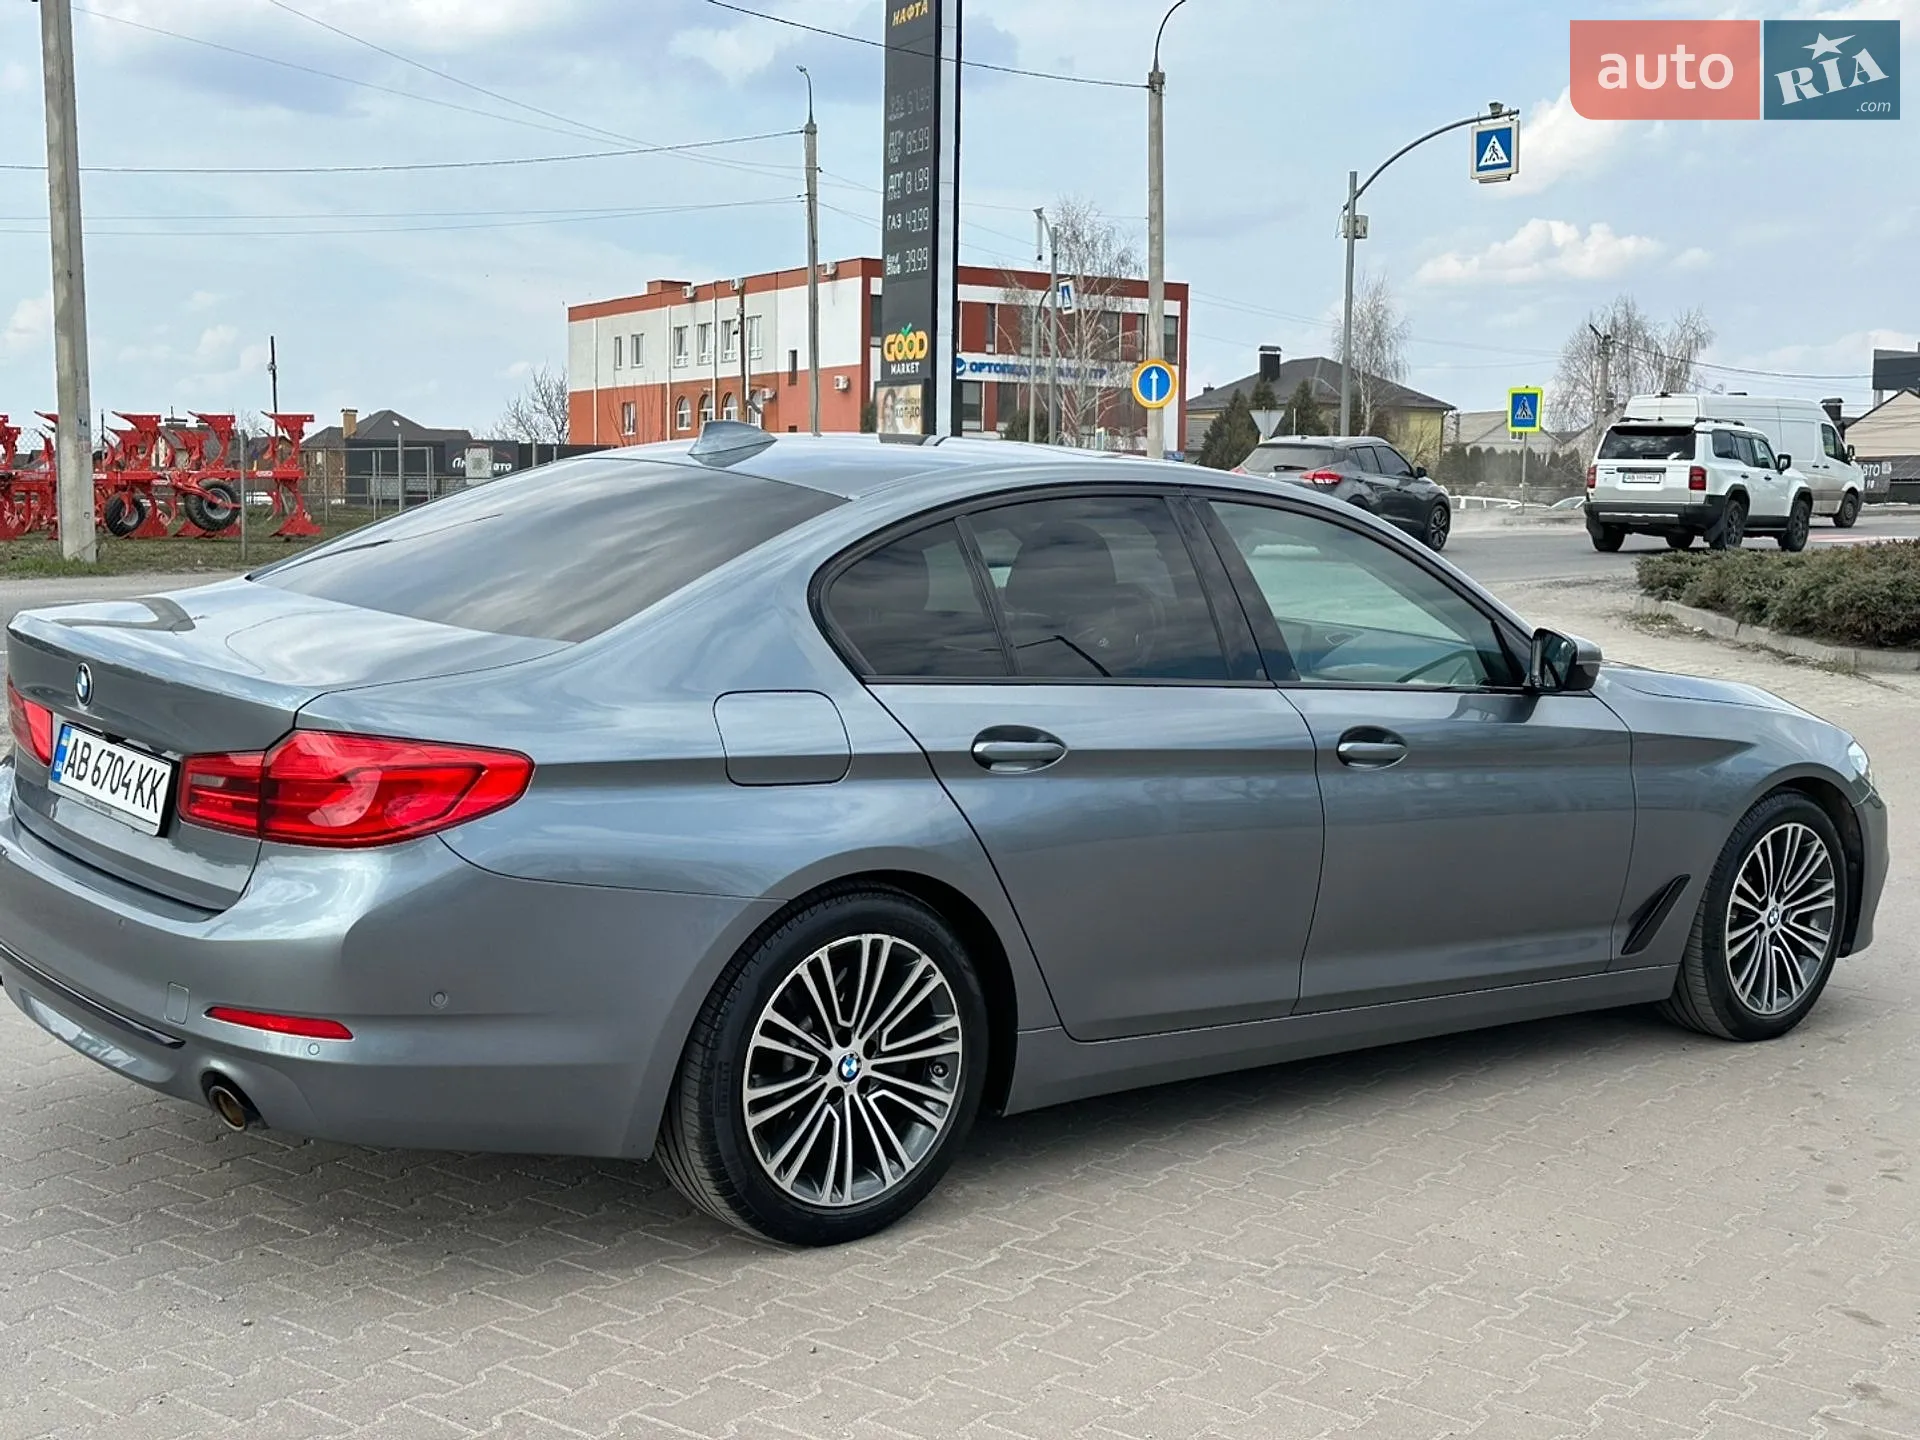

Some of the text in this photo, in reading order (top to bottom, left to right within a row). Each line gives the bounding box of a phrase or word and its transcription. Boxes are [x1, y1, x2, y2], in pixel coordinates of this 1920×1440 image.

[883, 330, 928, 362] GOOD
[890, 362, 920, 375] MARKET
[64, 737, 166, 814] AB 6704 KK
